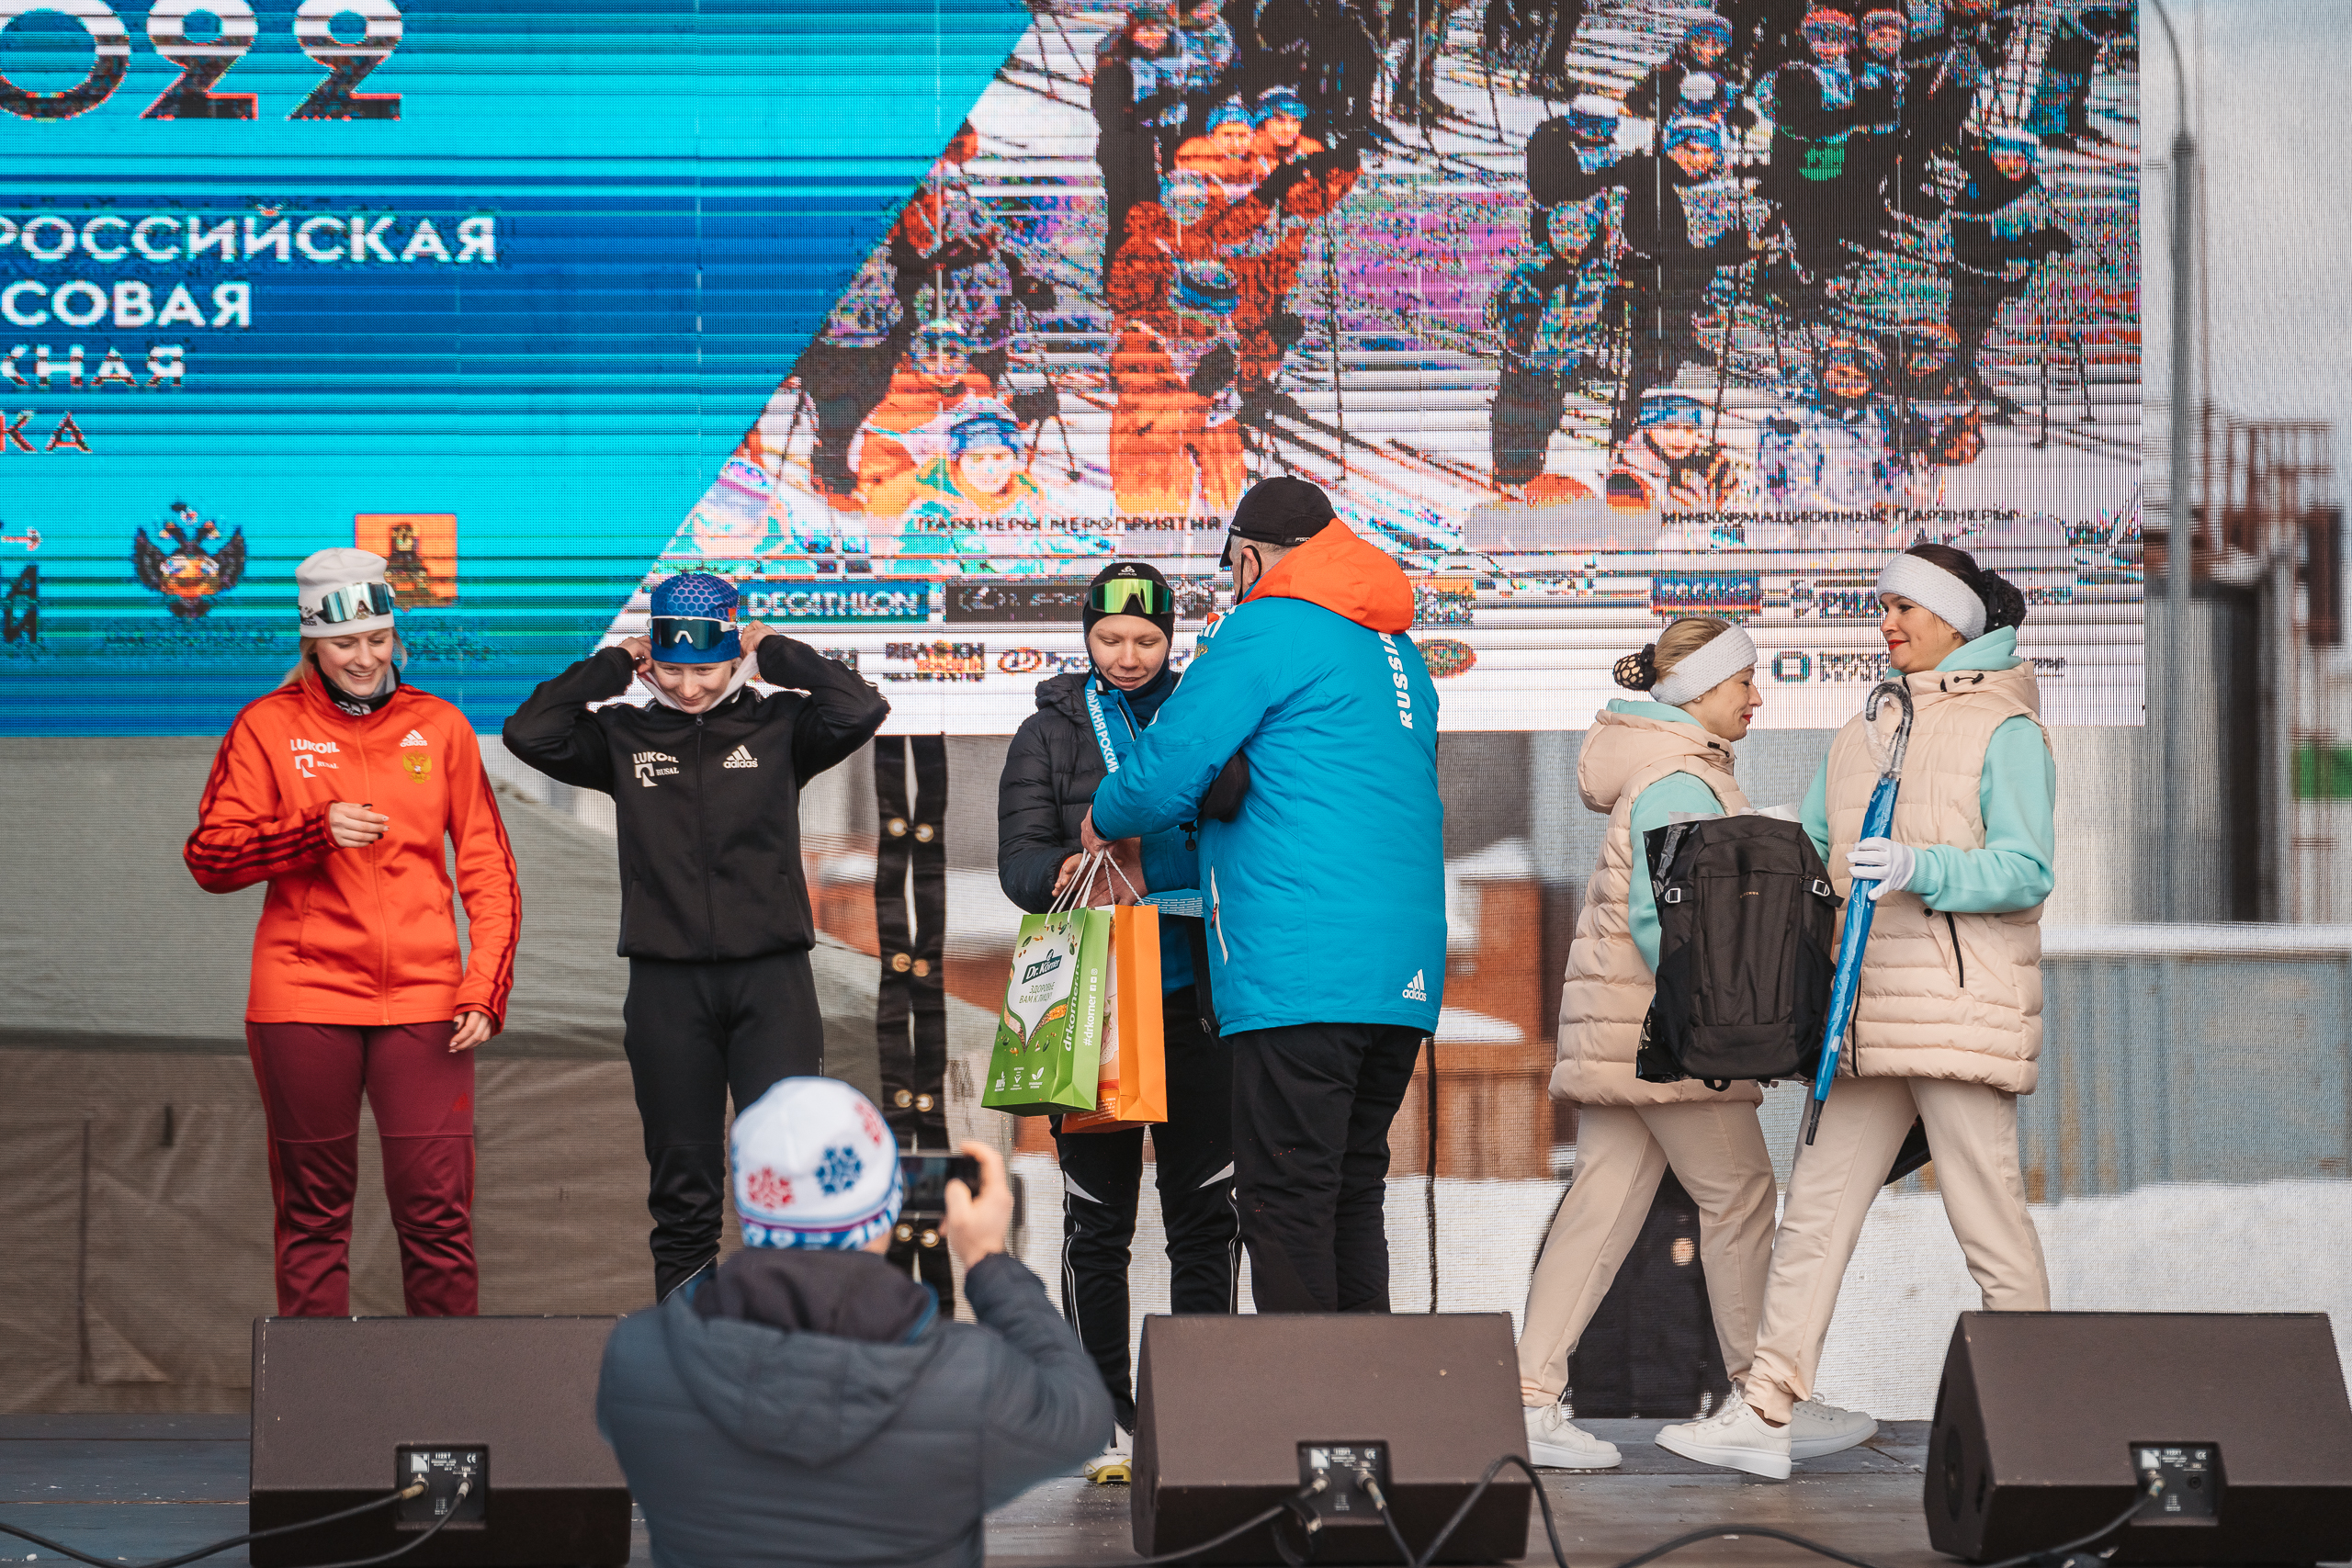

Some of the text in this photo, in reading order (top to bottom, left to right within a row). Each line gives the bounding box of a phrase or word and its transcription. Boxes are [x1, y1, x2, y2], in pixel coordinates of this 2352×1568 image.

[0, 0, 403, 120] 022
[2, 280, 251, 328] СОВАЯ
[0, 410, 93, 454] КА
[748, 591, 918, 616] DECATHLON
[1378, 632, 1413, 729] RUSSIA
[1086, 689, 1106, 731] ЛЫЖНЯ
[290, 739, 340, 754] LUKOIL
[400, 739, 428, 748] adidas
[317, 761, 339, 770] RUSAL
[633, 751, 679, 764] LUKOIL
[722, 759, 758, 769] adidas
[655, 767, 679, 776] RUSAL
[1402, 988, 1427, 1002] adidas
[1083, 994, 1096, 1046] #drkorner
